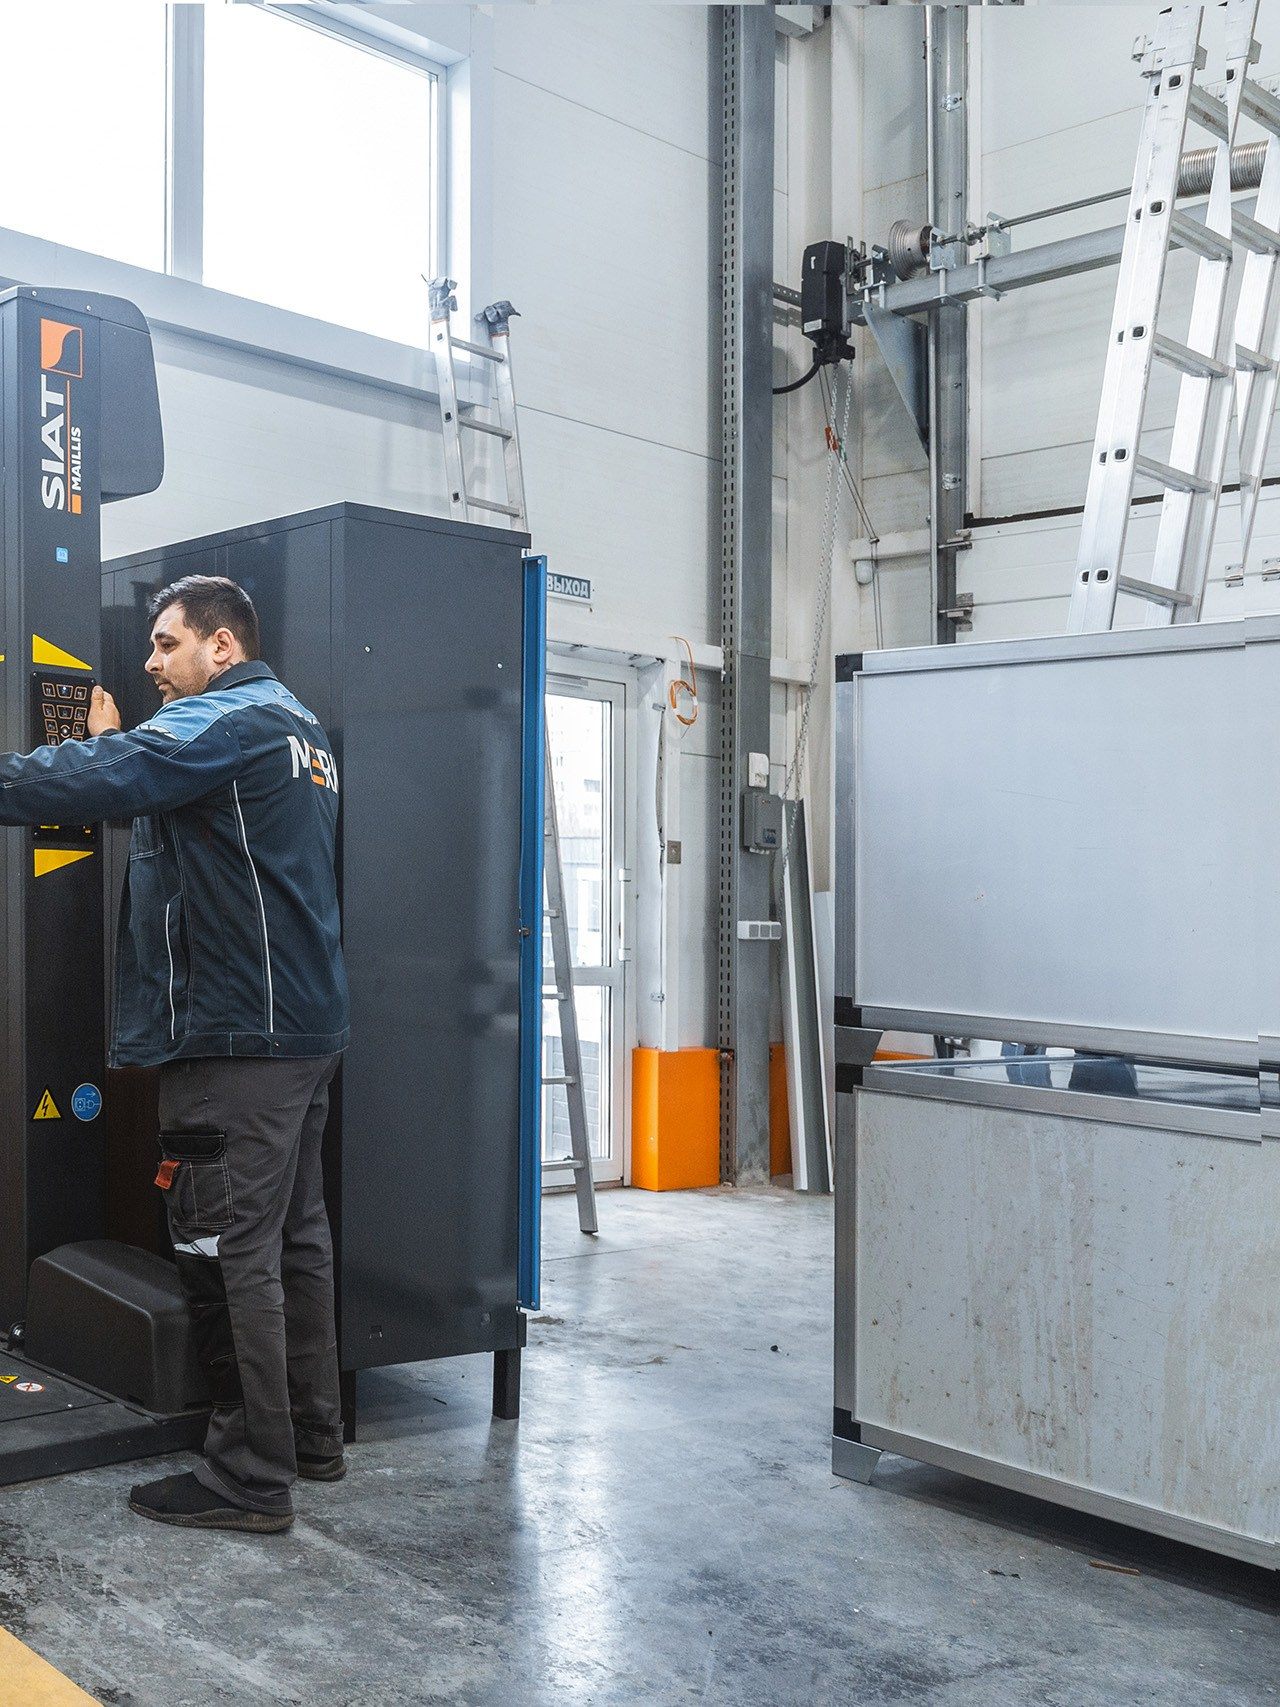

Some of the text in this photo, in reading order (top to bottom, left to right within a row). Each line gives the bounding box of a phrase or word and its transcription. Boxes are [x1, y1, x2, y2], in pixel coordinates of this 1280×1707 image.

[41, 374, 65, 511] SIAT
[71, 426, 82, 491] MAILLIS
[546, 573, 589, 598] ВЫХОД
